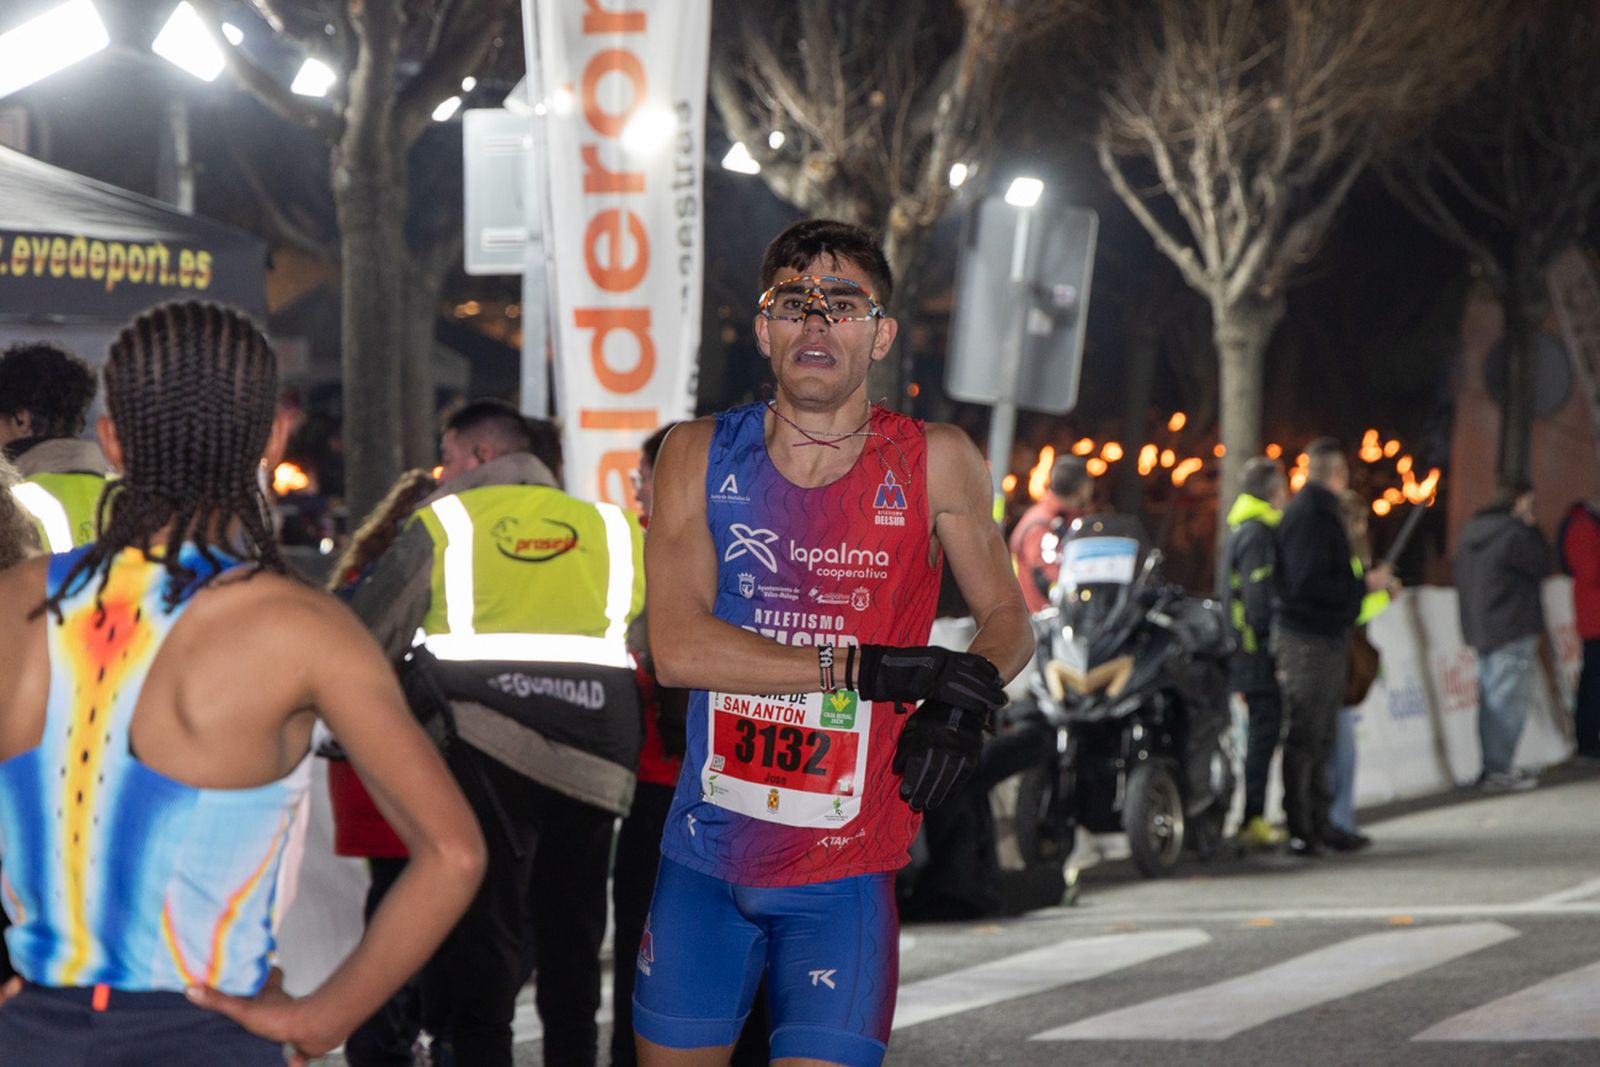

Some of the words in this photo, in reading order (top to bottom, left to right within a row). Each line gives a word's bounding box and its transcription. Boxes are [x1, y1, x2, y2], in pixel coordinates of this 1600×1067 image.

[0, 235, 214, 293] .evedeport.es
[874, 515, 906, 527] DELSUR
[790, 540, 890, 571] lapalma
[816, 566, 888, 581] cooperativa
[754, 608, 844, 631] ATLETISMO
[722, 695, 751, 716] SAN
[752, 702, 806, 725] ANTÓN
[734, 719, 832, 777] 3132
